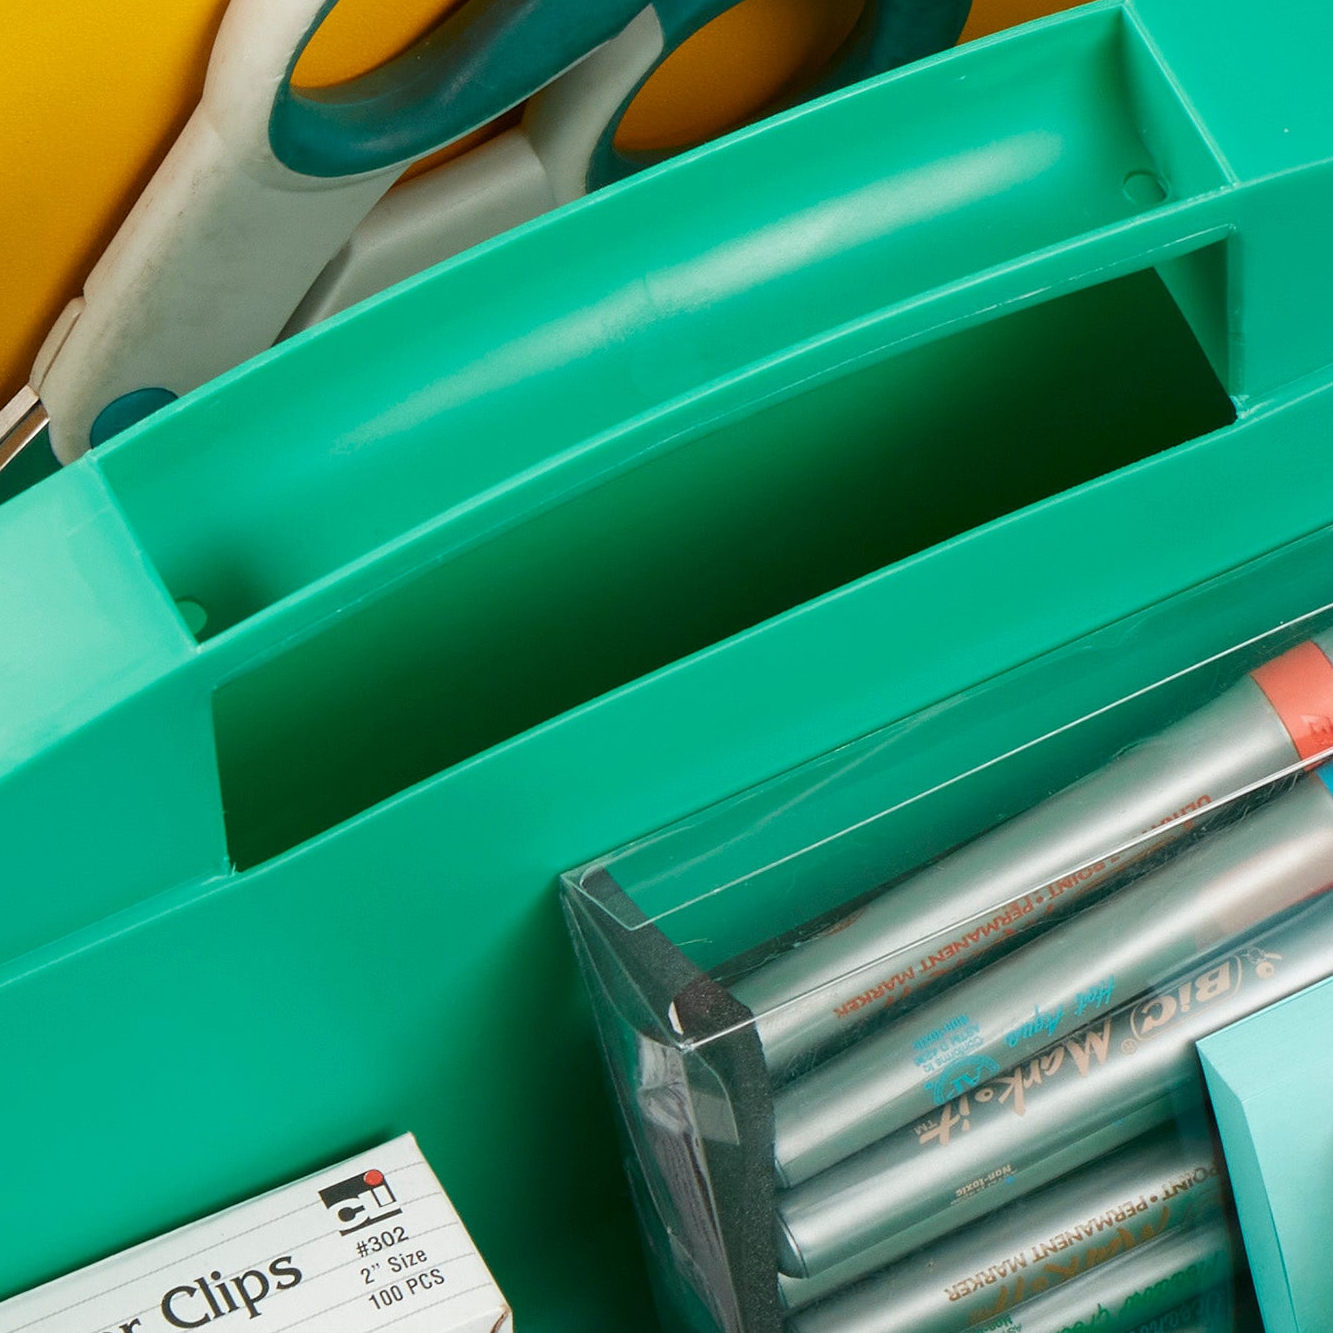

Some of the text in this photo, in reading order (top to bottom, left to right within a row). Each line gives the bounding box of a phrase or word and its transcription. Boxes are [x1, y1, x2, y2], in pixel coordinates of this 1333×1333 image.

[919, 894, 1034, 973] PERMANENT
[833, 966, 915, 1018] MARKER
[356, 1226, 409, 1257] #302
[1031, 1194, 1150, 1263] PERMANENT
[387, 1249, 428, 1274] Size
[944, 1253, 1028, 1302] MARKER
[160, 1256, 303, 1329] Clips
[368, 1268, 445, 1310] 100 PCS
